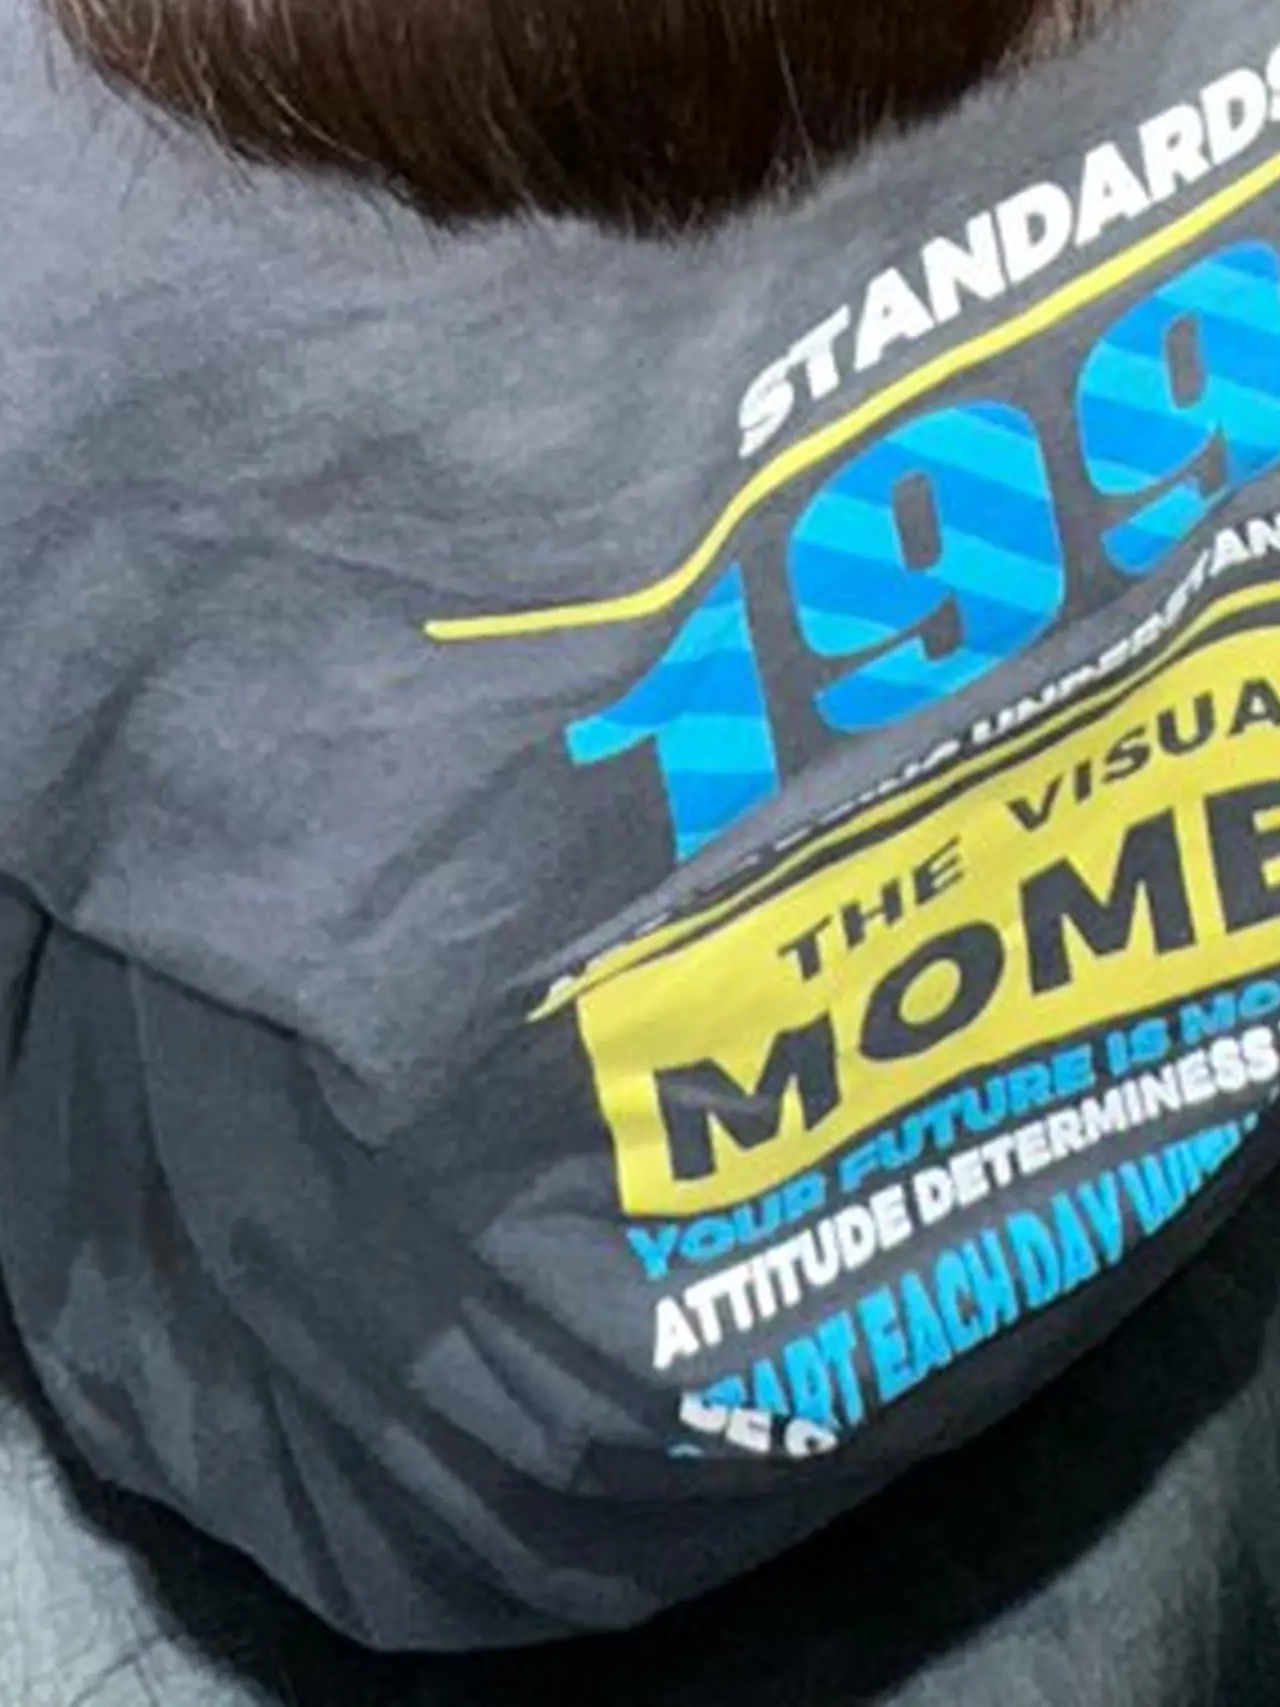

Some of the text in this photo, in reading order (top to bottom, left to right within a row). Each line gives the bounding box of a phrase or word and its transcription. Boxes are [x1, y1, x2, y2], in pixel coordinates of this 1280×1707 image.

[778, 835, 962, 982] THE
[626, 1171, 826, 1281] YOUR
[838, 1043, 1097, 1194] FUTURE
[1106, 1018, 1170, 1077] IS
[653, 1185, 914, 1371] ATTITUDE
[913, 1024, 1280, 1225] DETERMINESS
[857, 1223, 1020, 1405] EACH
[1004, 1171, 1124, 1309] DAY
